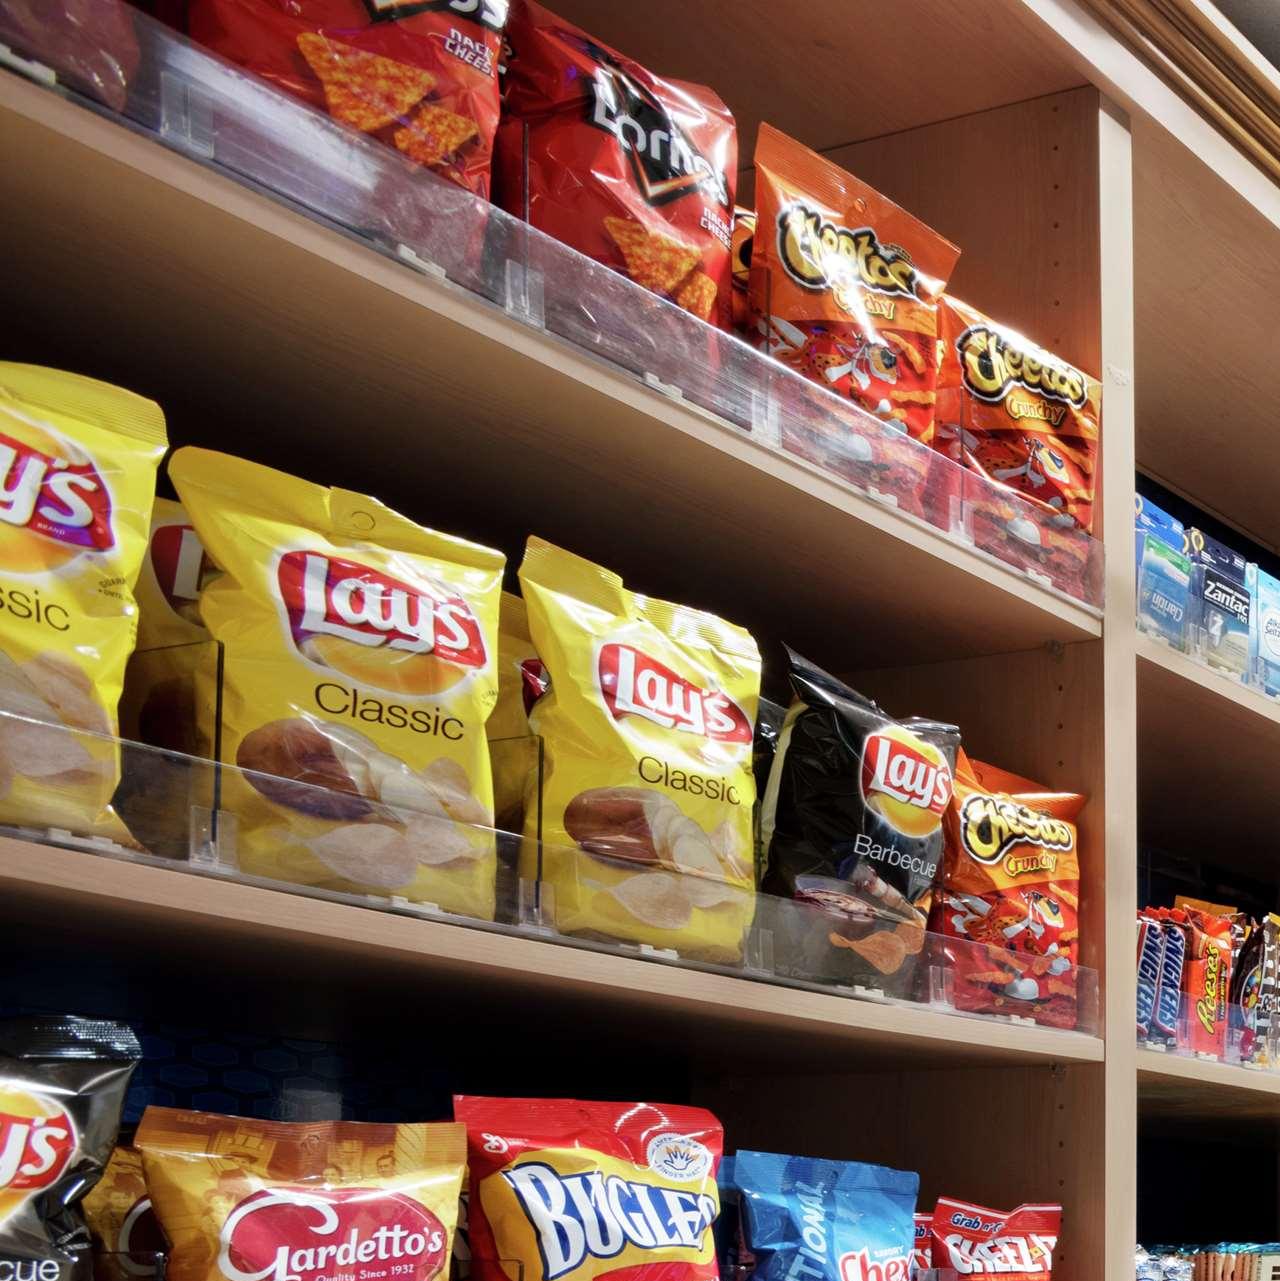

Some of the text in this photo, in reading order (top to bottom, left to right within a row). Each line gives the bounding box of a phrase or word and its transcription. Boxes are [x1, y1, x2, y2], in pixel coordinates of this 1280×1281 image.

[1204, 580, 1249, 614] Zantac
[315, 683, 464, 741] Classic
[615, 646, 737, 734] Lay's
[638, 756, 741, 805] Classic
[869, 738, 951, 808] Lay's
[853, 833, 937, 878] Barbecue
[1157, 926, 1185, 1031] SNICKERS
[1196, 943, 1220, 1034] Reese's
[951, 1213, 981, 1231] Grab
[359, 1267, 388, 1280] Since
[391, 1263, 415, 1276] 1932
